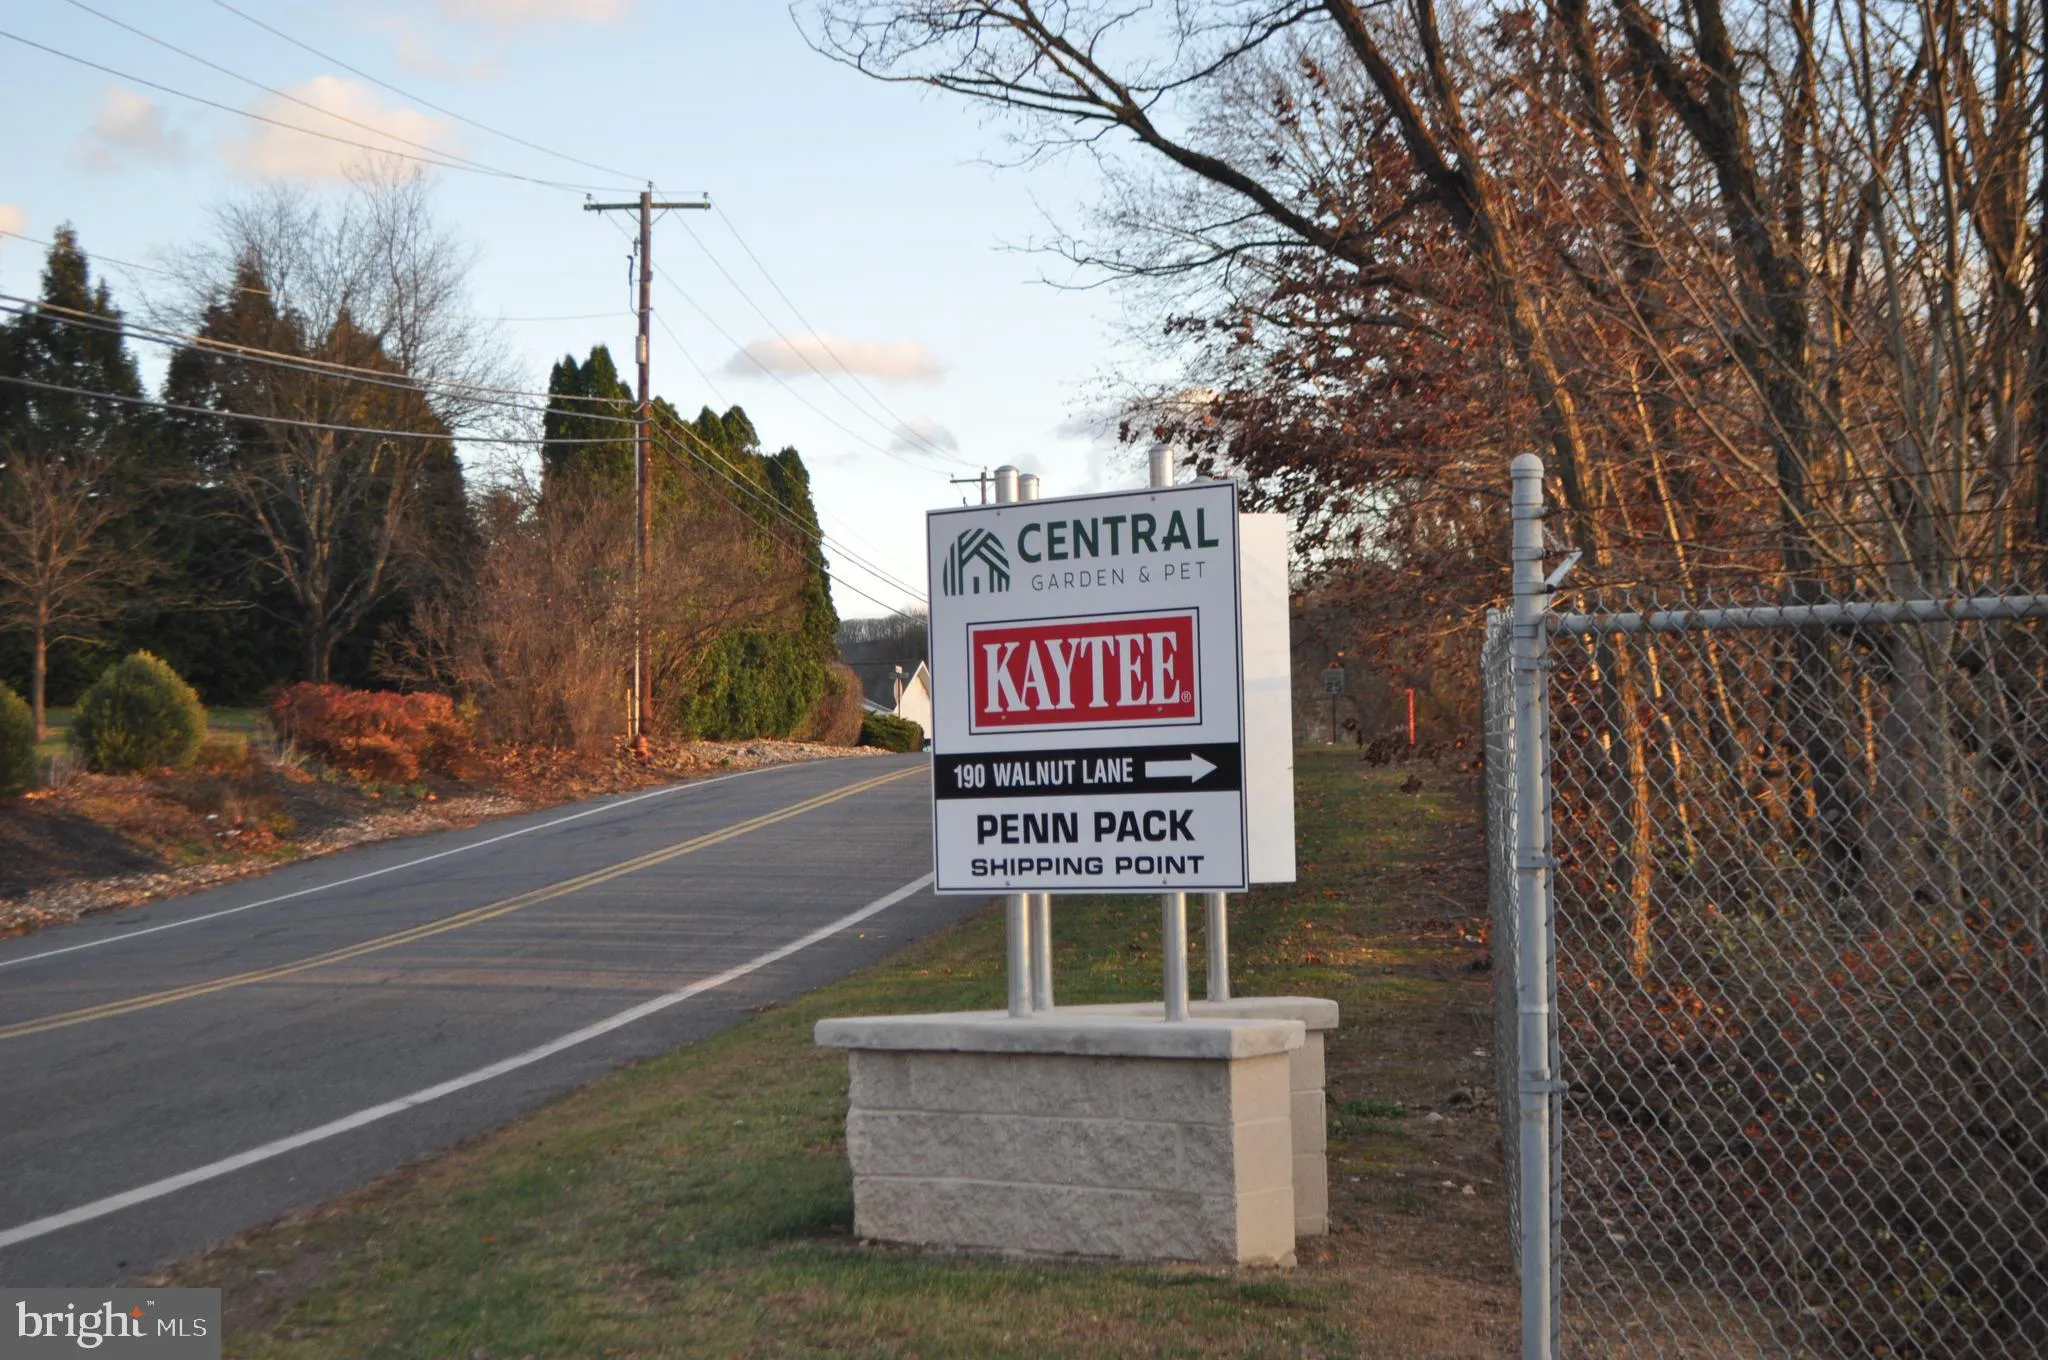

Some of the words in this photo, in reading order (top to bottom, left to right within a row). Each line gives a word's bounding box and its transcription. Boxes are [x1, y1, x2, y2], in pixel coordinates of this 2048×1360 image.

[1017, 508, 1219, 563] CENTRAL
[1031, 567, 1125, 591] GARDEN
[1138, 565, 1150, 583] &
[1164, 561, 1206, 581] PET
[953, 764, 985, 789] 190
[993, 760, 1076, 787] WALNUT
[1082, 757, 1133, 784] LANE
[976, 812, 1078, 845] PENN
[1094, 809, 1196, 842] PACK
[971, 857, 1103, 877] SHIPPING
[1115, 855, 1205, 875] POINT
